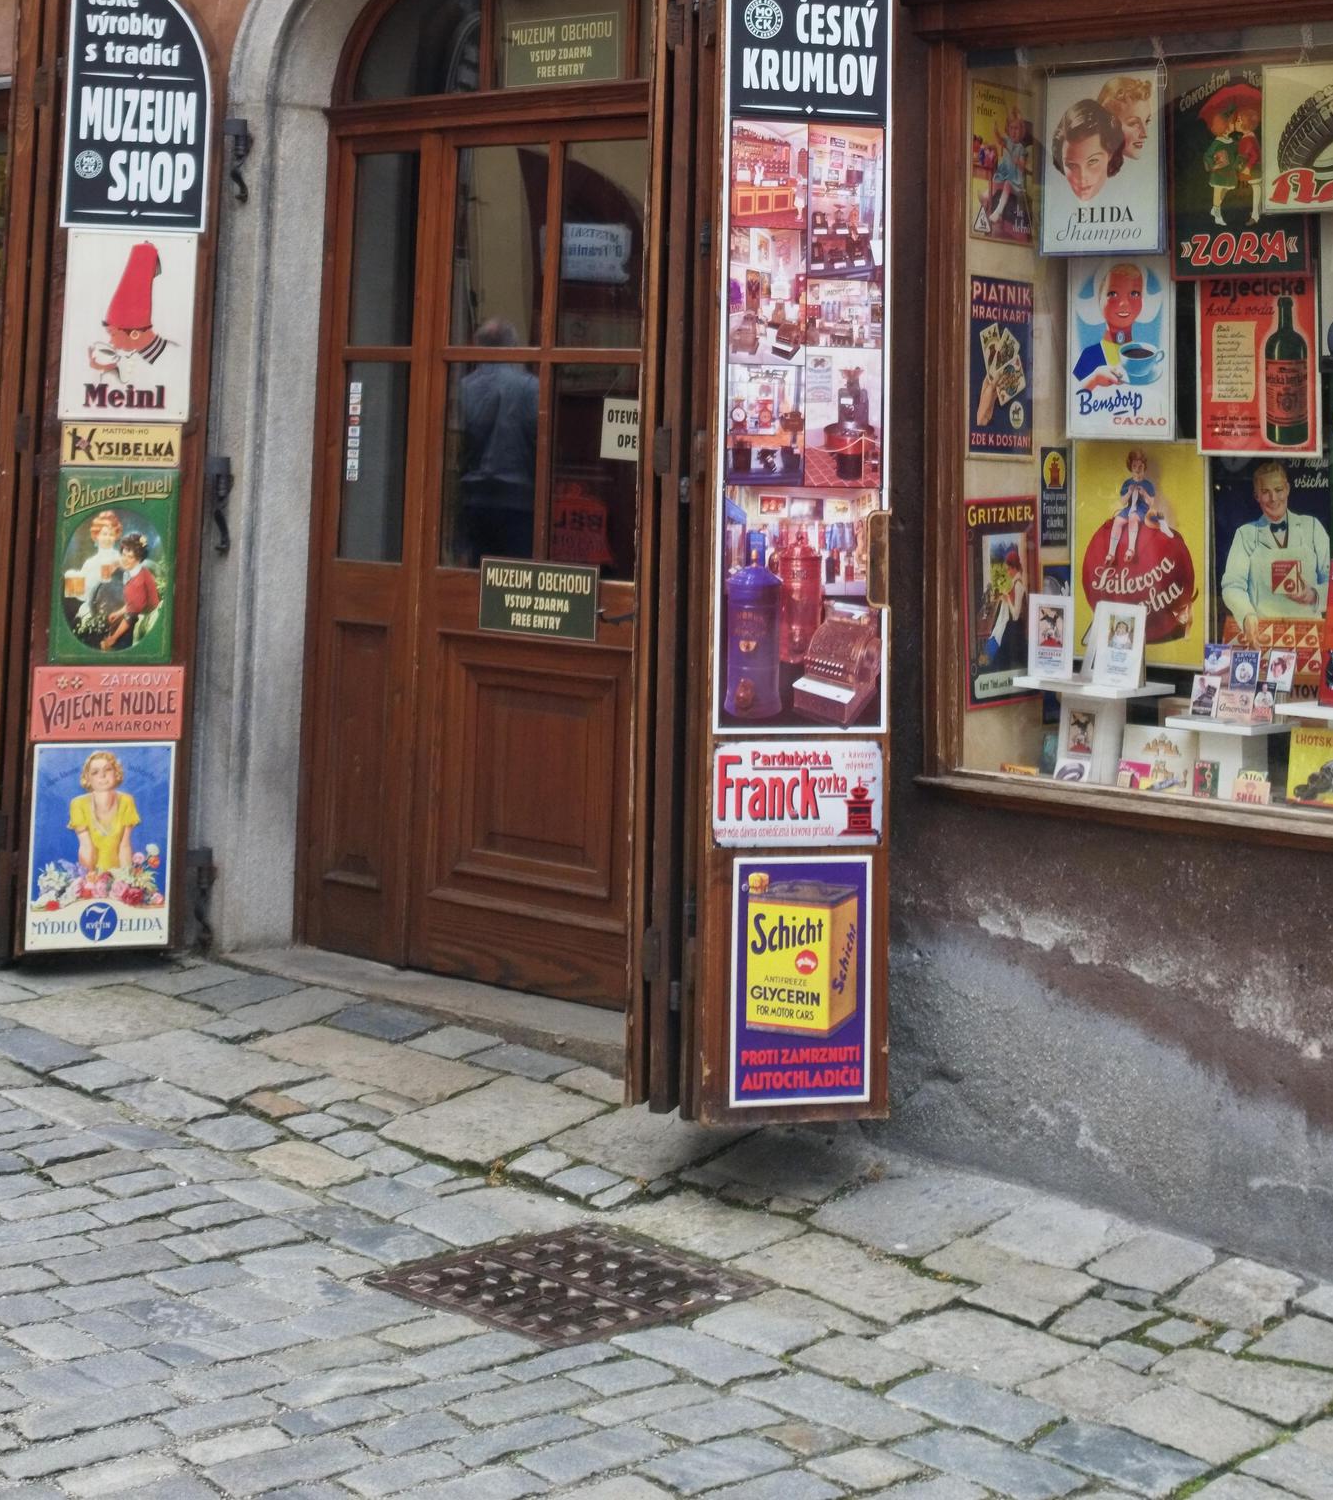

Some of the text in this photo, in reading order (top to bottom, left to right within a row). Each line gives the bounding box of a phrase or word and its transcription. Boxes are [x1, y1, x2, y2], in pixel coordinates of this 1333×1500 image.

[86, 11, 167, 39] výrobky
[512, 20, 612, 47] MUZEUM OBCHODU
[85, 42, 180, 67] s tradicí
[530, 46, 592, 62] VSTUP ZDARMA
[537, 63, 584, 78] FREE ENTRY
[742, 48, 878, 96] KRUMLOV
[79, 85, 197, 145] MUZEUM
[107, 149, 196, 203] SHOP
[1076, 205, 1134, 224] ELIDA
[1055, 212, 1142, 245] Shampoo
[972, 280, 1033, 306] PIATNIK
[83, 383, 166, 410] Meinl
[1076, 387, 1143, 417] Bensdorp
[1113, 416, 1167, 427] CACAO
[68, 428, 175, 461] KYSIBELKA
[971, 432, 987, 447] ZDE
[988, 433, 995, 447] K
[64, 474, 173, 517] Pilsner Urquell
[967, 504, 1034, 527] GRITZNER
[486, 567, 591, 595] MUZEUM OBCHODU
[1092, 556, 1176, 595] Seilerova
[505, 594, 569, 613] VSTUP ZDARMA
[511, 612, 561, 631] FREE ENTRY
[39, 688, 177, 734] VAJEČNÉ NUDLE
[78, 722, 86, 731] A
[750, 750, 833, 766] Pardubická
[1236, 792, 1263, 805] SHELL
[32, 918, 77, 935] MÝDLO
[85, 904, 111, 941] 7
[120, 917, 163, 933] ELIDA
[750, 913, 823, 956] Schicht
[831, 923, 857, 996] Schicht
[763, 974, 808, 988] ANTIFREEZE
[750, 985, 821, 1007] GLYCERIN
[756, 1004, 815, 1021] FOR MOTOR CARS
[740, 1043, 861, 1067] PROTI ZAMRZNUTÍ
